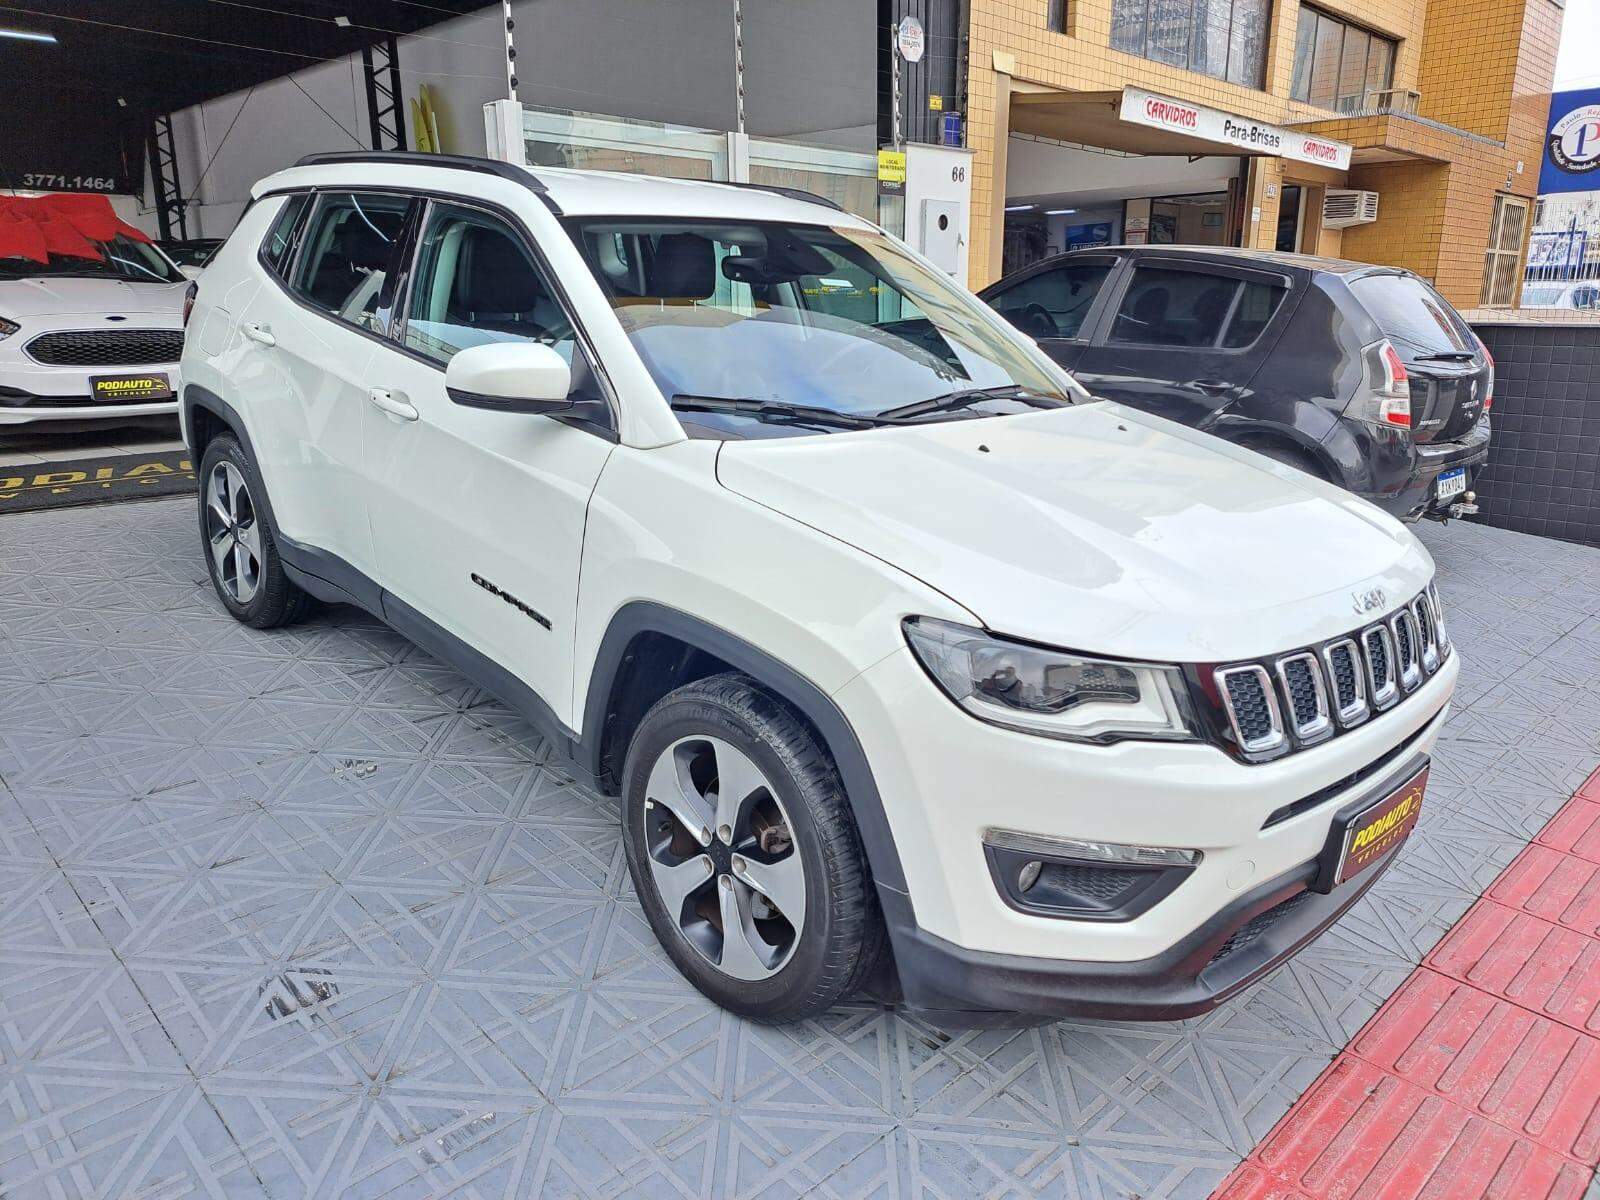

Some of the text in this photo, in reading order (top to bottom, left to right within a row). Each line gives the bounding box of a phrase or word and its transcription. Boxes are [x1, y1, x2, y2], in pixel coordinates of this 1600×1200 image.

[1146, 100, 1197, 127] CARVIDROS
[1560, 113, 1581, 128] Paulo
[1303, 140, 1338, 160] CARVIDROS
[23, 173, 115, 190] 3771.1464
[952, 166, 965, 182] 66
[97, 379, 152, 390] PODIAUTO
[1350, 586, 1386, 615] Jeep
[1351, 796, 1413, 853] PODIAUTO
